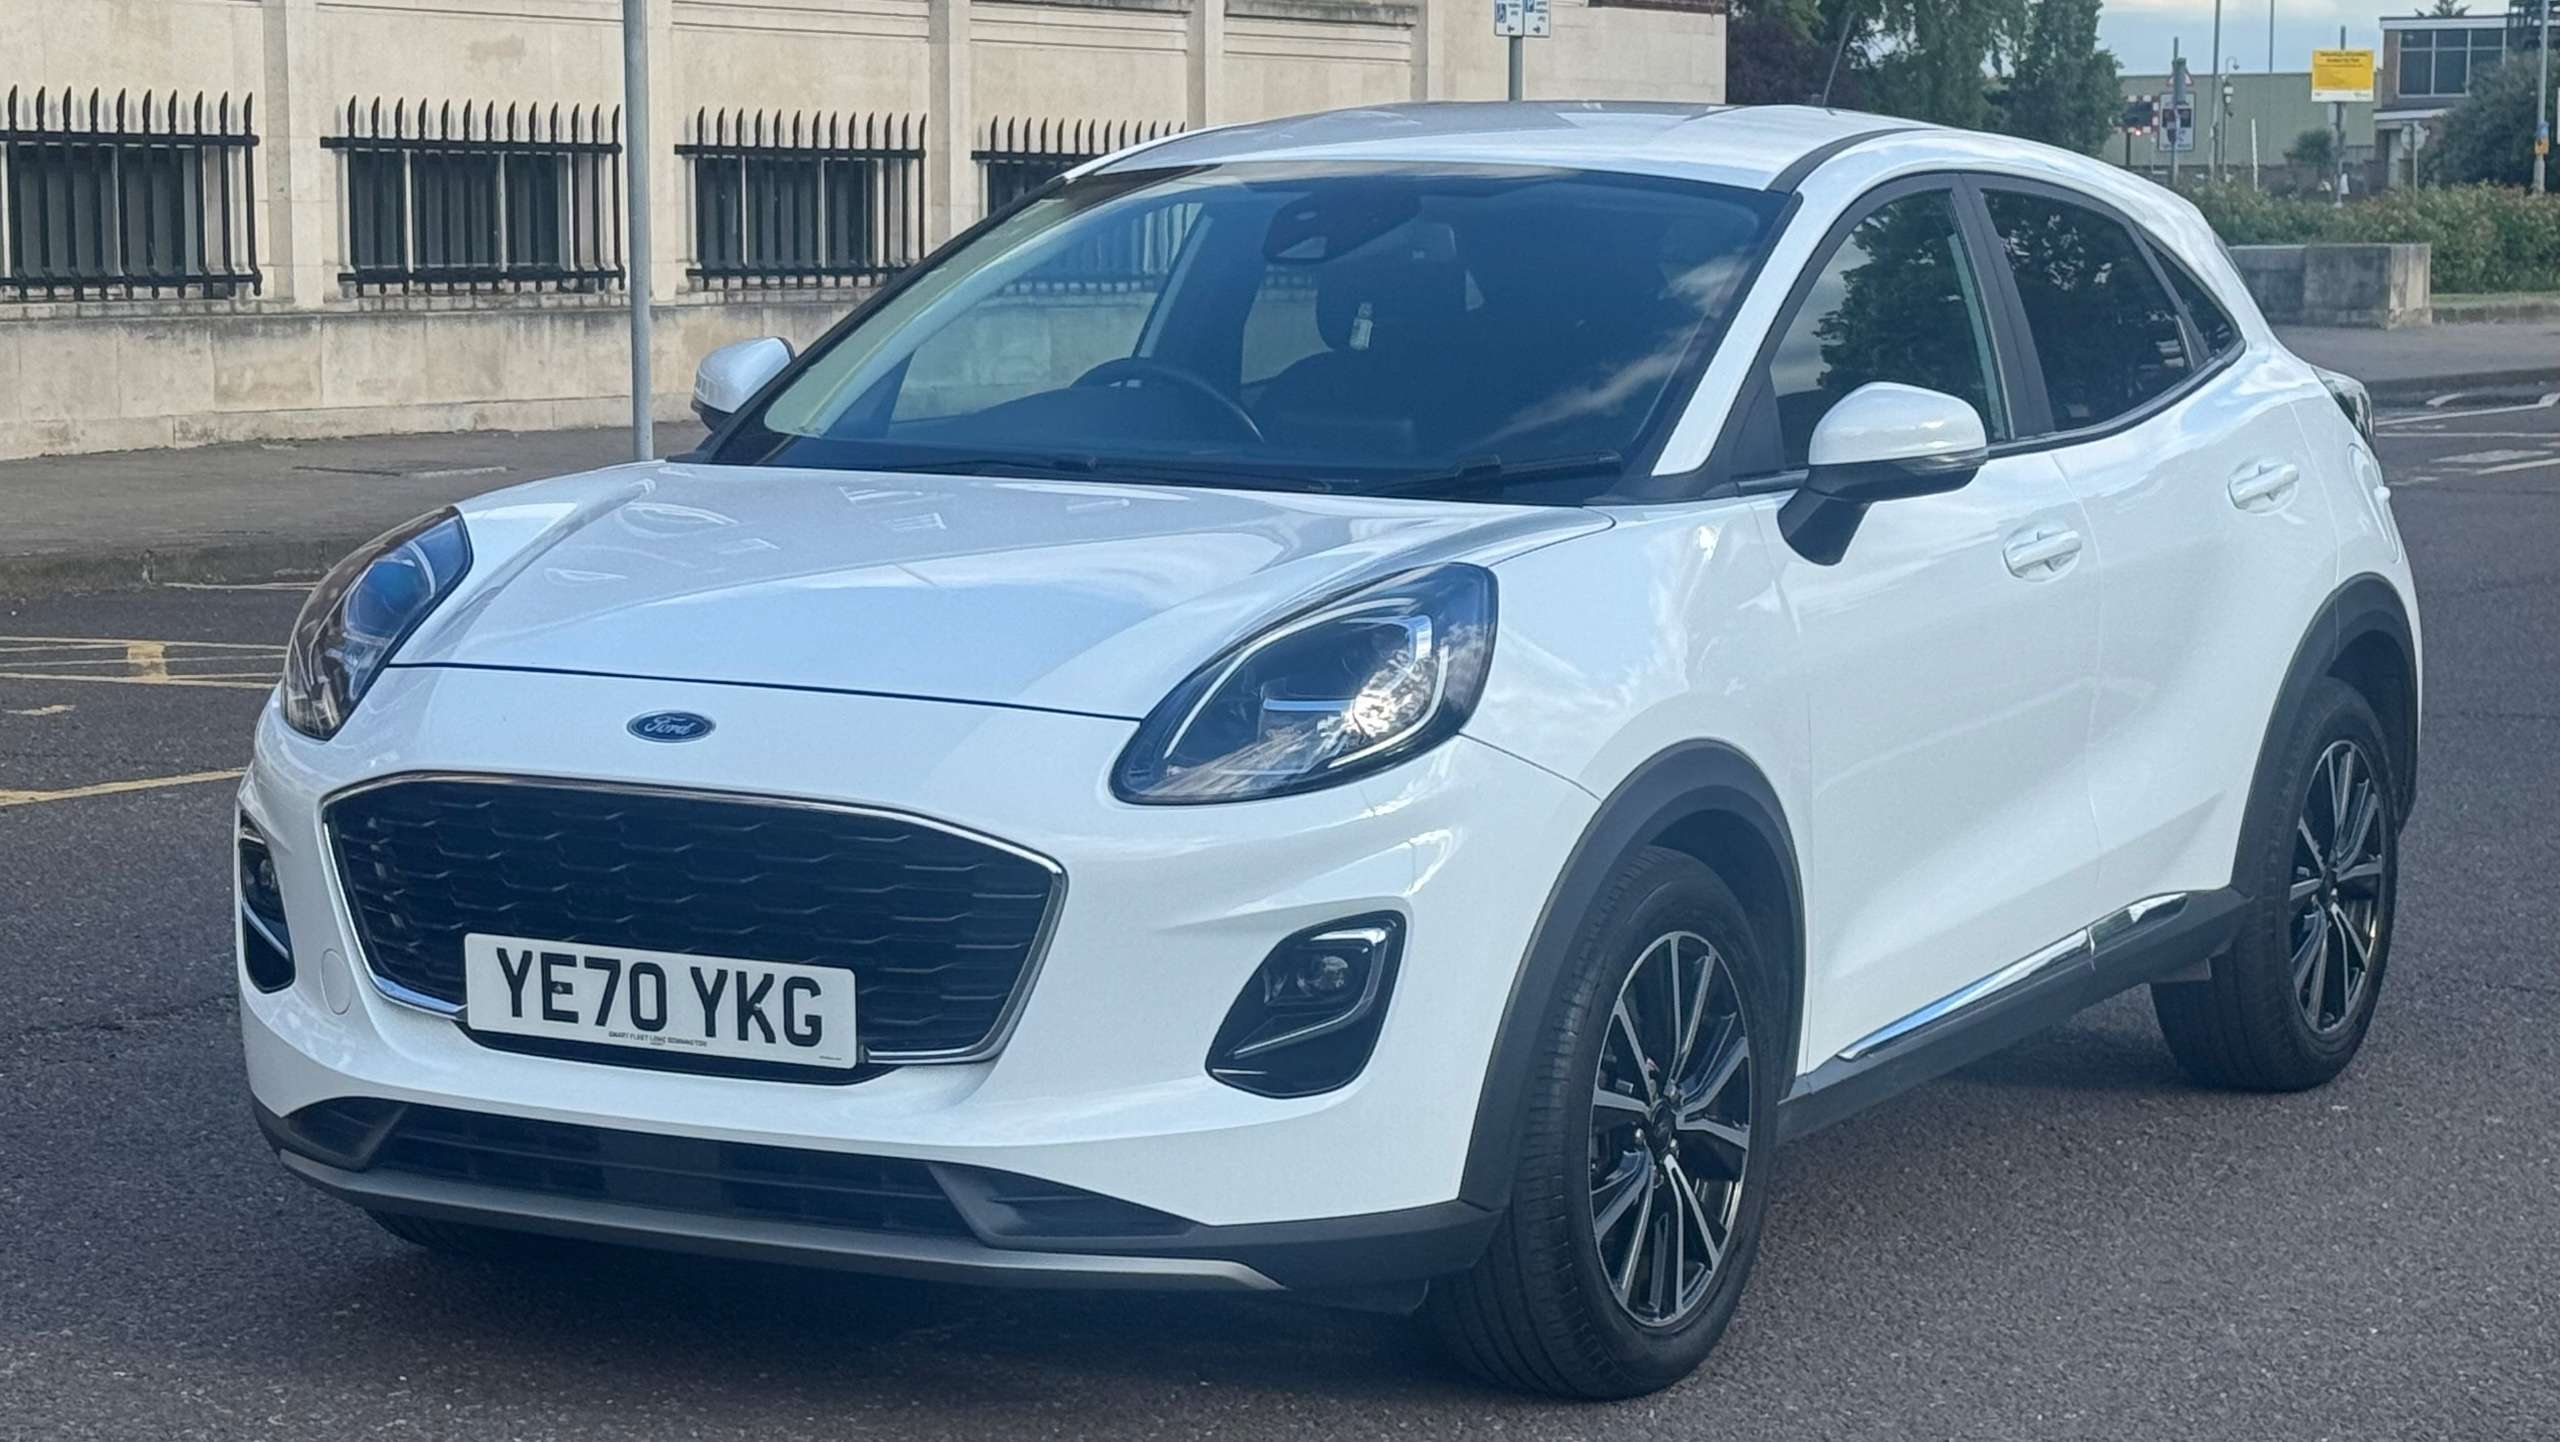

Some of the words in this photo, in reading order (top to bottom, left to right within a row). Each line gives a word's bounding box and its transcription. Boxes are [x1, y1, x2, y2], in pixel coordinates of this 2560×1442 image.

[643, 715, 697, 735] Ford
[496, 947, 668, 1033] YE70
[689, 966, 823, 1048] YKG
